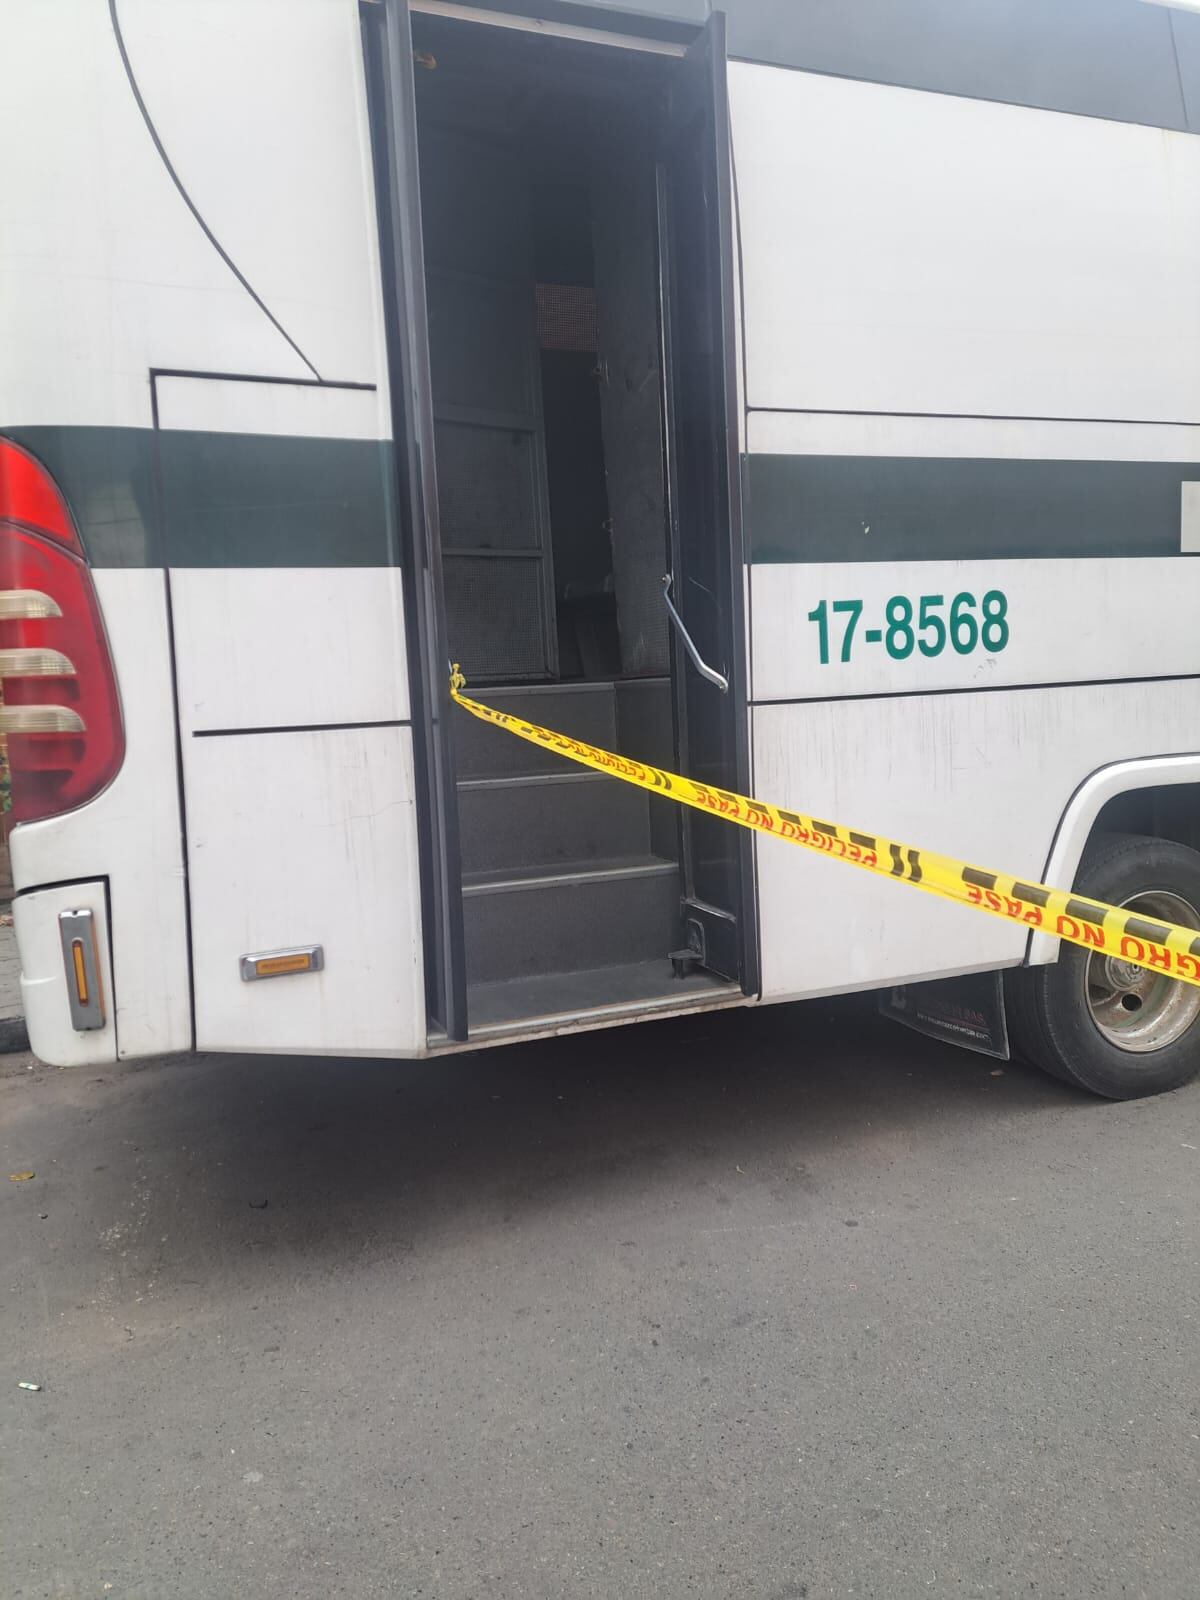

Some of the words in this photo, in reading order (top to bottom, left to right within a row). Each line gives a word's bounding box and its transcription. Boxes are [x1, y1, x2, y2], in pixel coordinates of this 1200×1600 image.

[808, 590, 1009, 664] 17-8568
[745, 806, 775, 832] NO
[780, 819, 878, 867] PELIGRO
[965, 881, 1045, 927] PASE
[1055, 914, 1106, 949] NO
